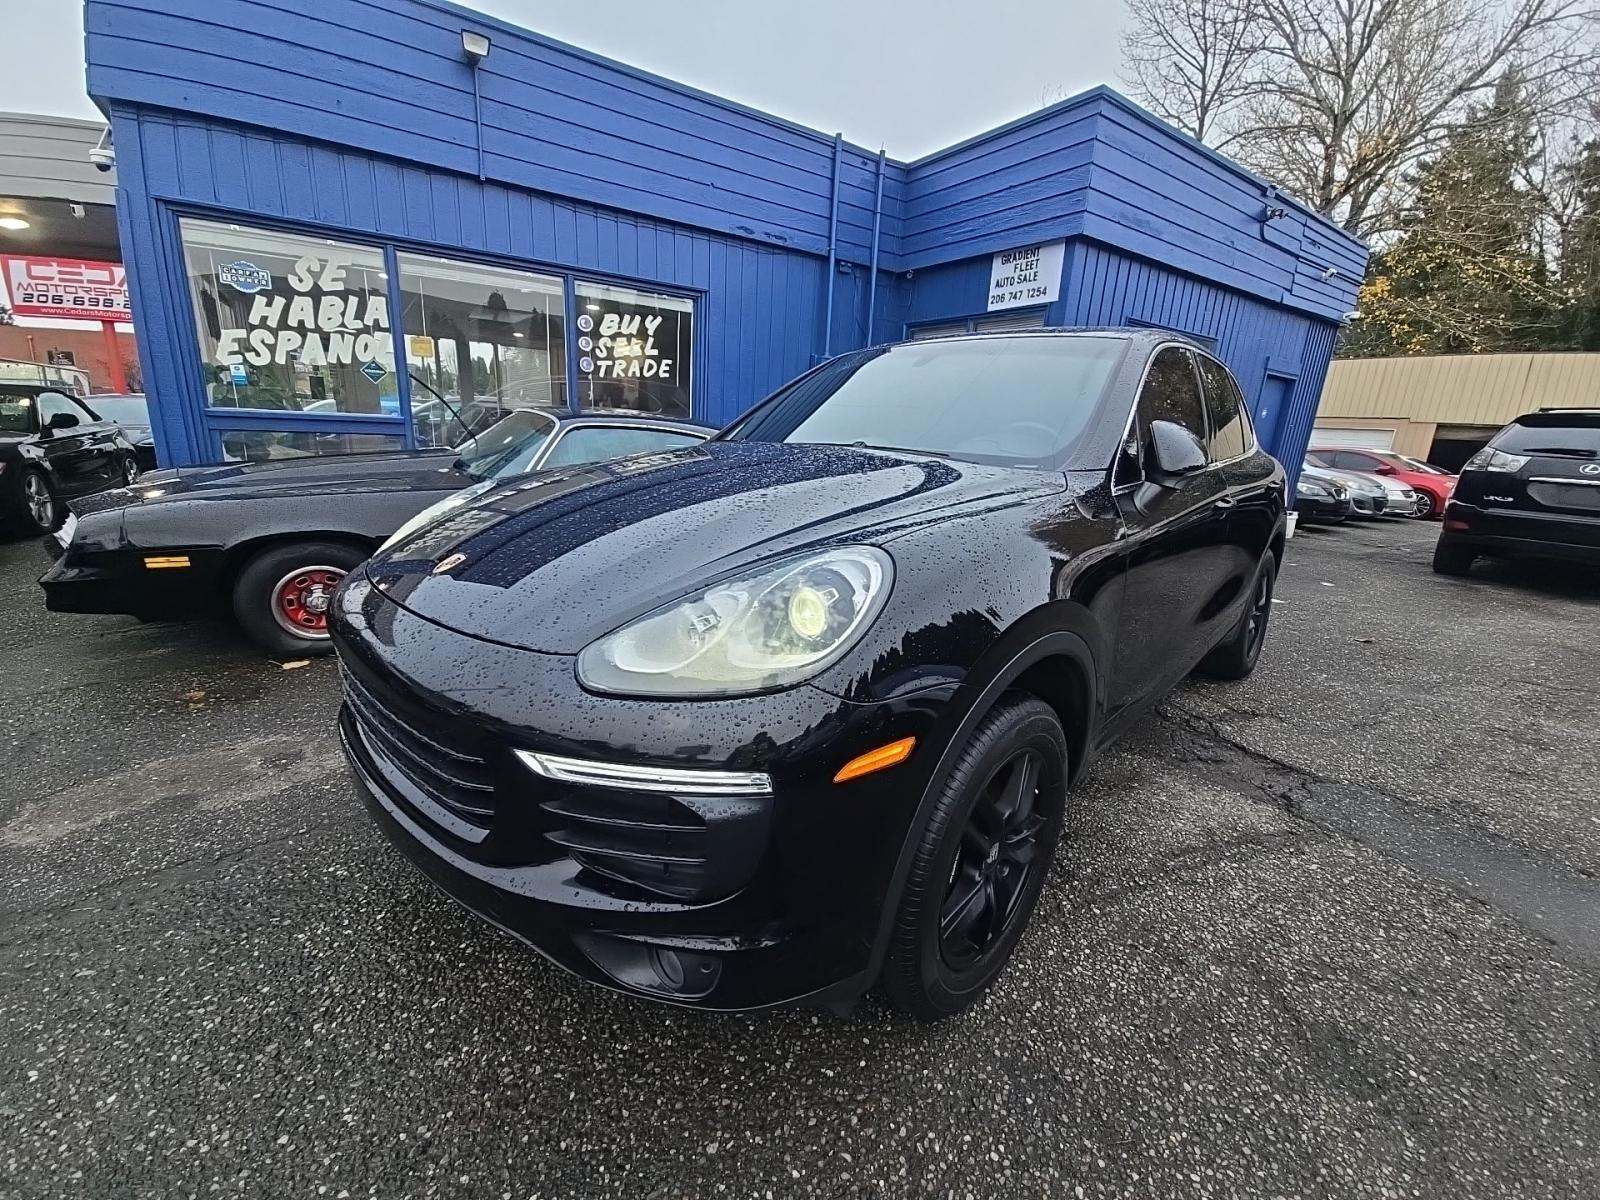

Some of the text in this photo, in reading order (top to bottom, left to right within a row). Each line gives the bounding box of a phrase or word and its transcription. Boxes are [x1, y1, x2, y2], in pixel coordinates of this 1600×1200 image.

[1001, 248, 1040, 265] GRADIENT
[1014, 259, 1040, 273] FLEET
[287, 254, 352, 293] SE
[995, 271, 1039, 289] AUTO SALE
[990, 286, 1047, 304] 206 747 1254
[248, 294, 390, 332] HABLA
[599, 313, 663, 336] BUY
[595, 335, 659, 358] SELL
[596, 358, 673, 378] TRADE
